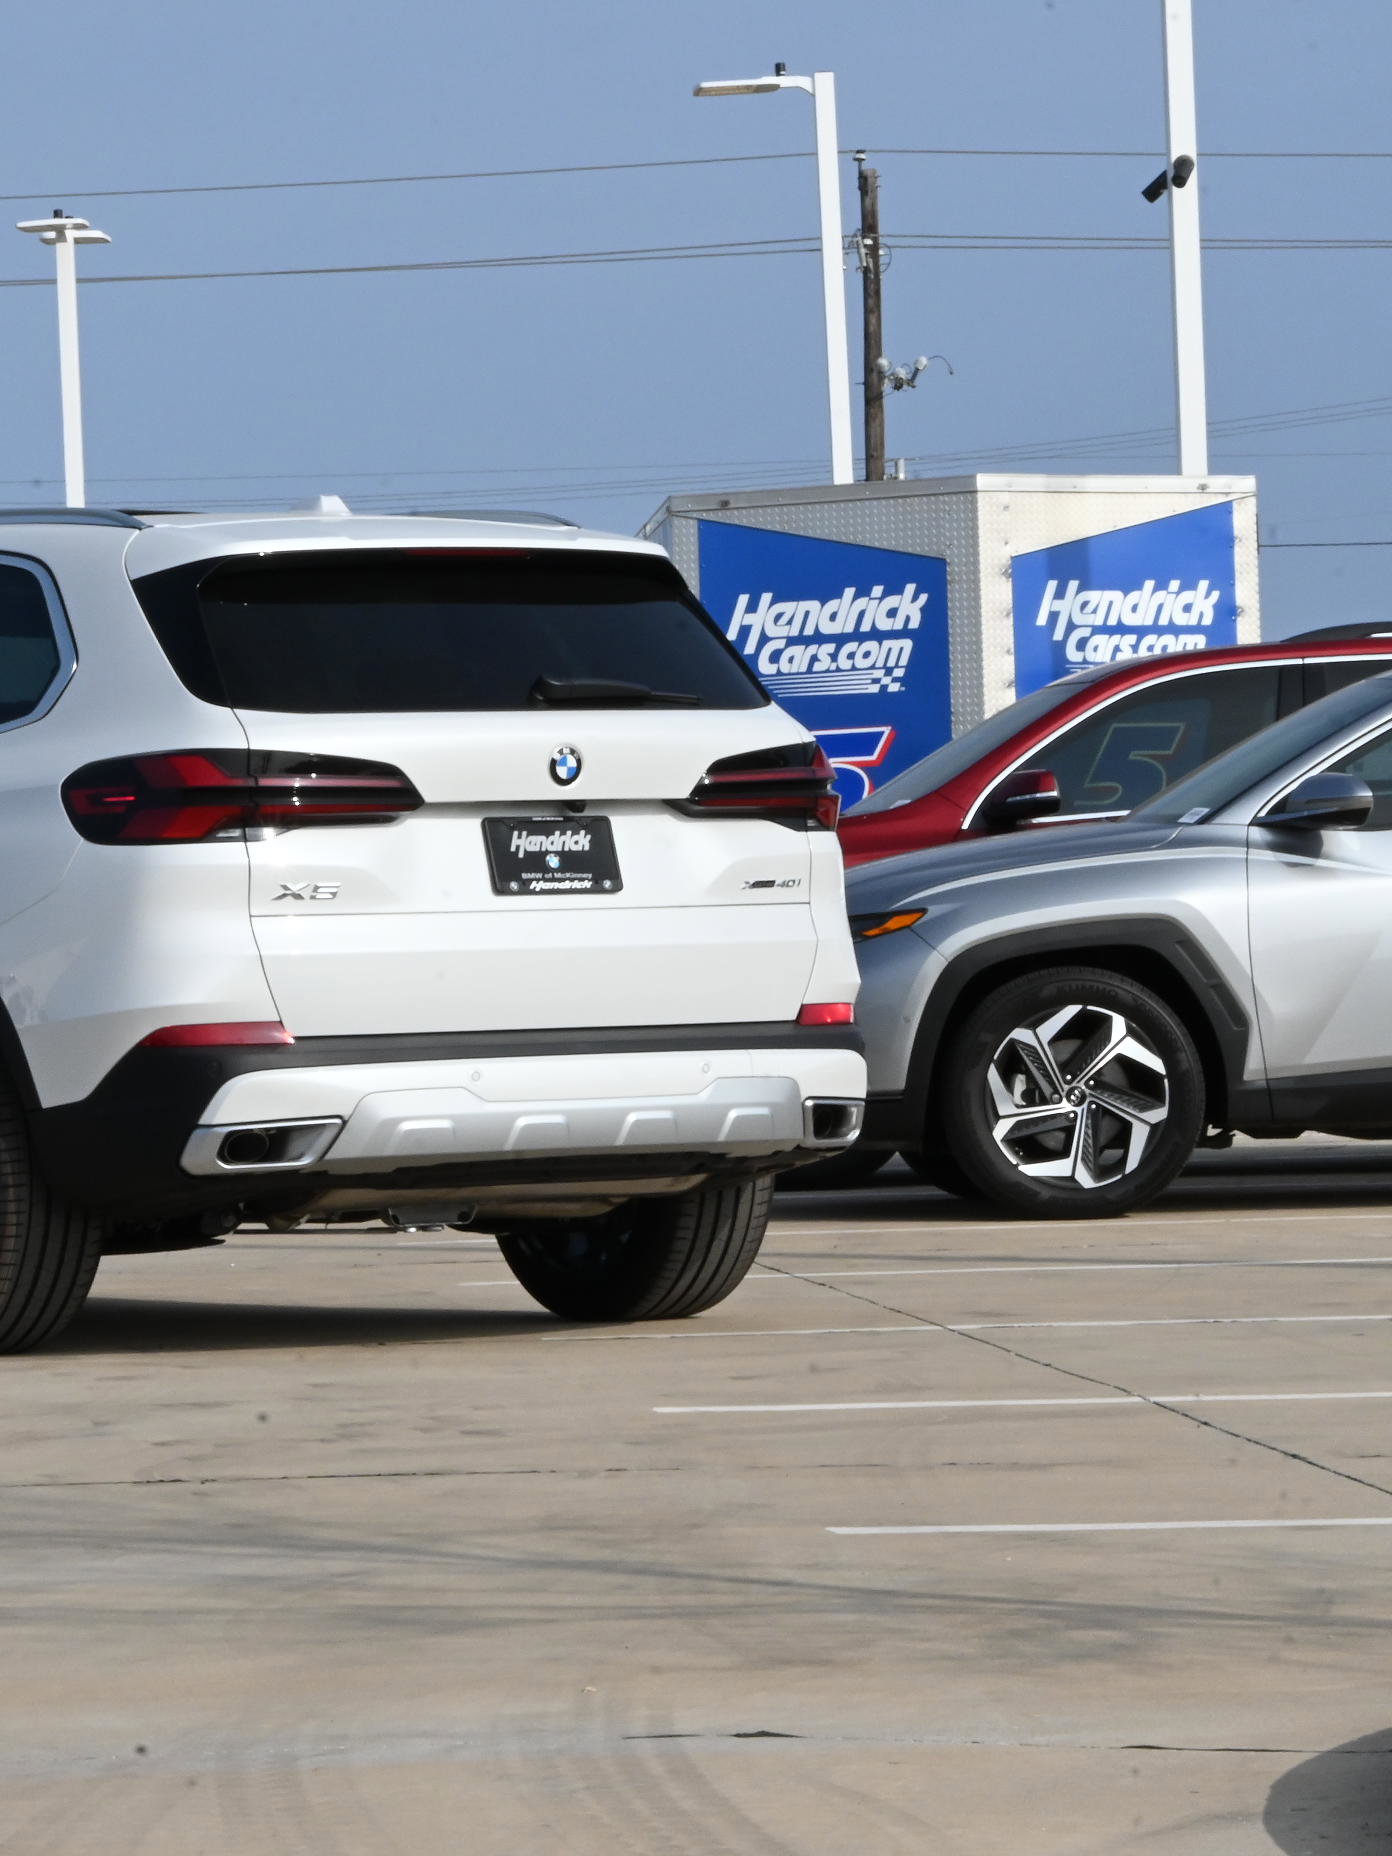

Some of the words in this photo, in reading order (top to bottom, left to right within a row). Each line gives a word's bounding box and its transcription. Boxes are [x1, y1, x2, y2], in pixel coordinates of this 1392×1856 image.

[726, 583, 929, 655] Hendrick
[1035, 579, 1221, 641] Hendrick
[757, 638, 913, 675] Cars.com
[510, 830, 592, 858] Hendrick
[270, 880, 342, 902] X5
[529, 880, 592, 891] Hendrick
